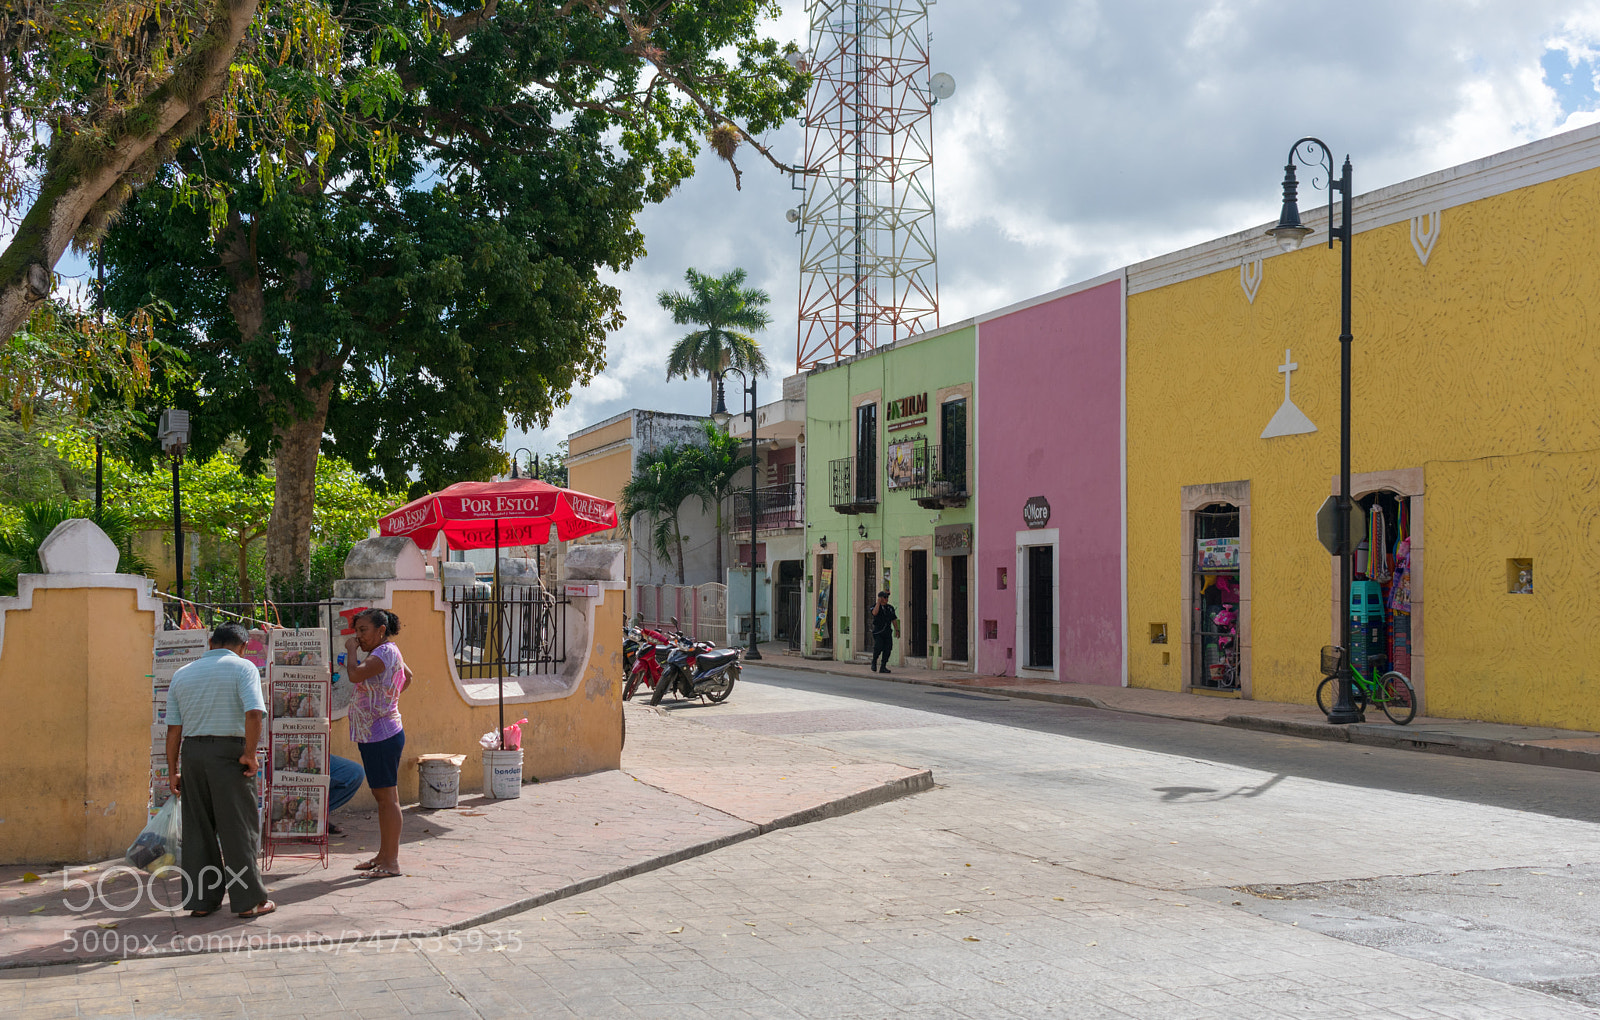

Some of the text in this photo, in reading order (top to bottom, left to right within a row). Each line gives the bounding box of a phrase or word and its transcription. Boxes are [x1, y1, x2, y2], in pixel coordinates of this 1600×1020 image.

[460, 496, 539, 512] POR ESTO!
[572, 496, 588, 512] POR
[388, 515, 405, 532] POR
